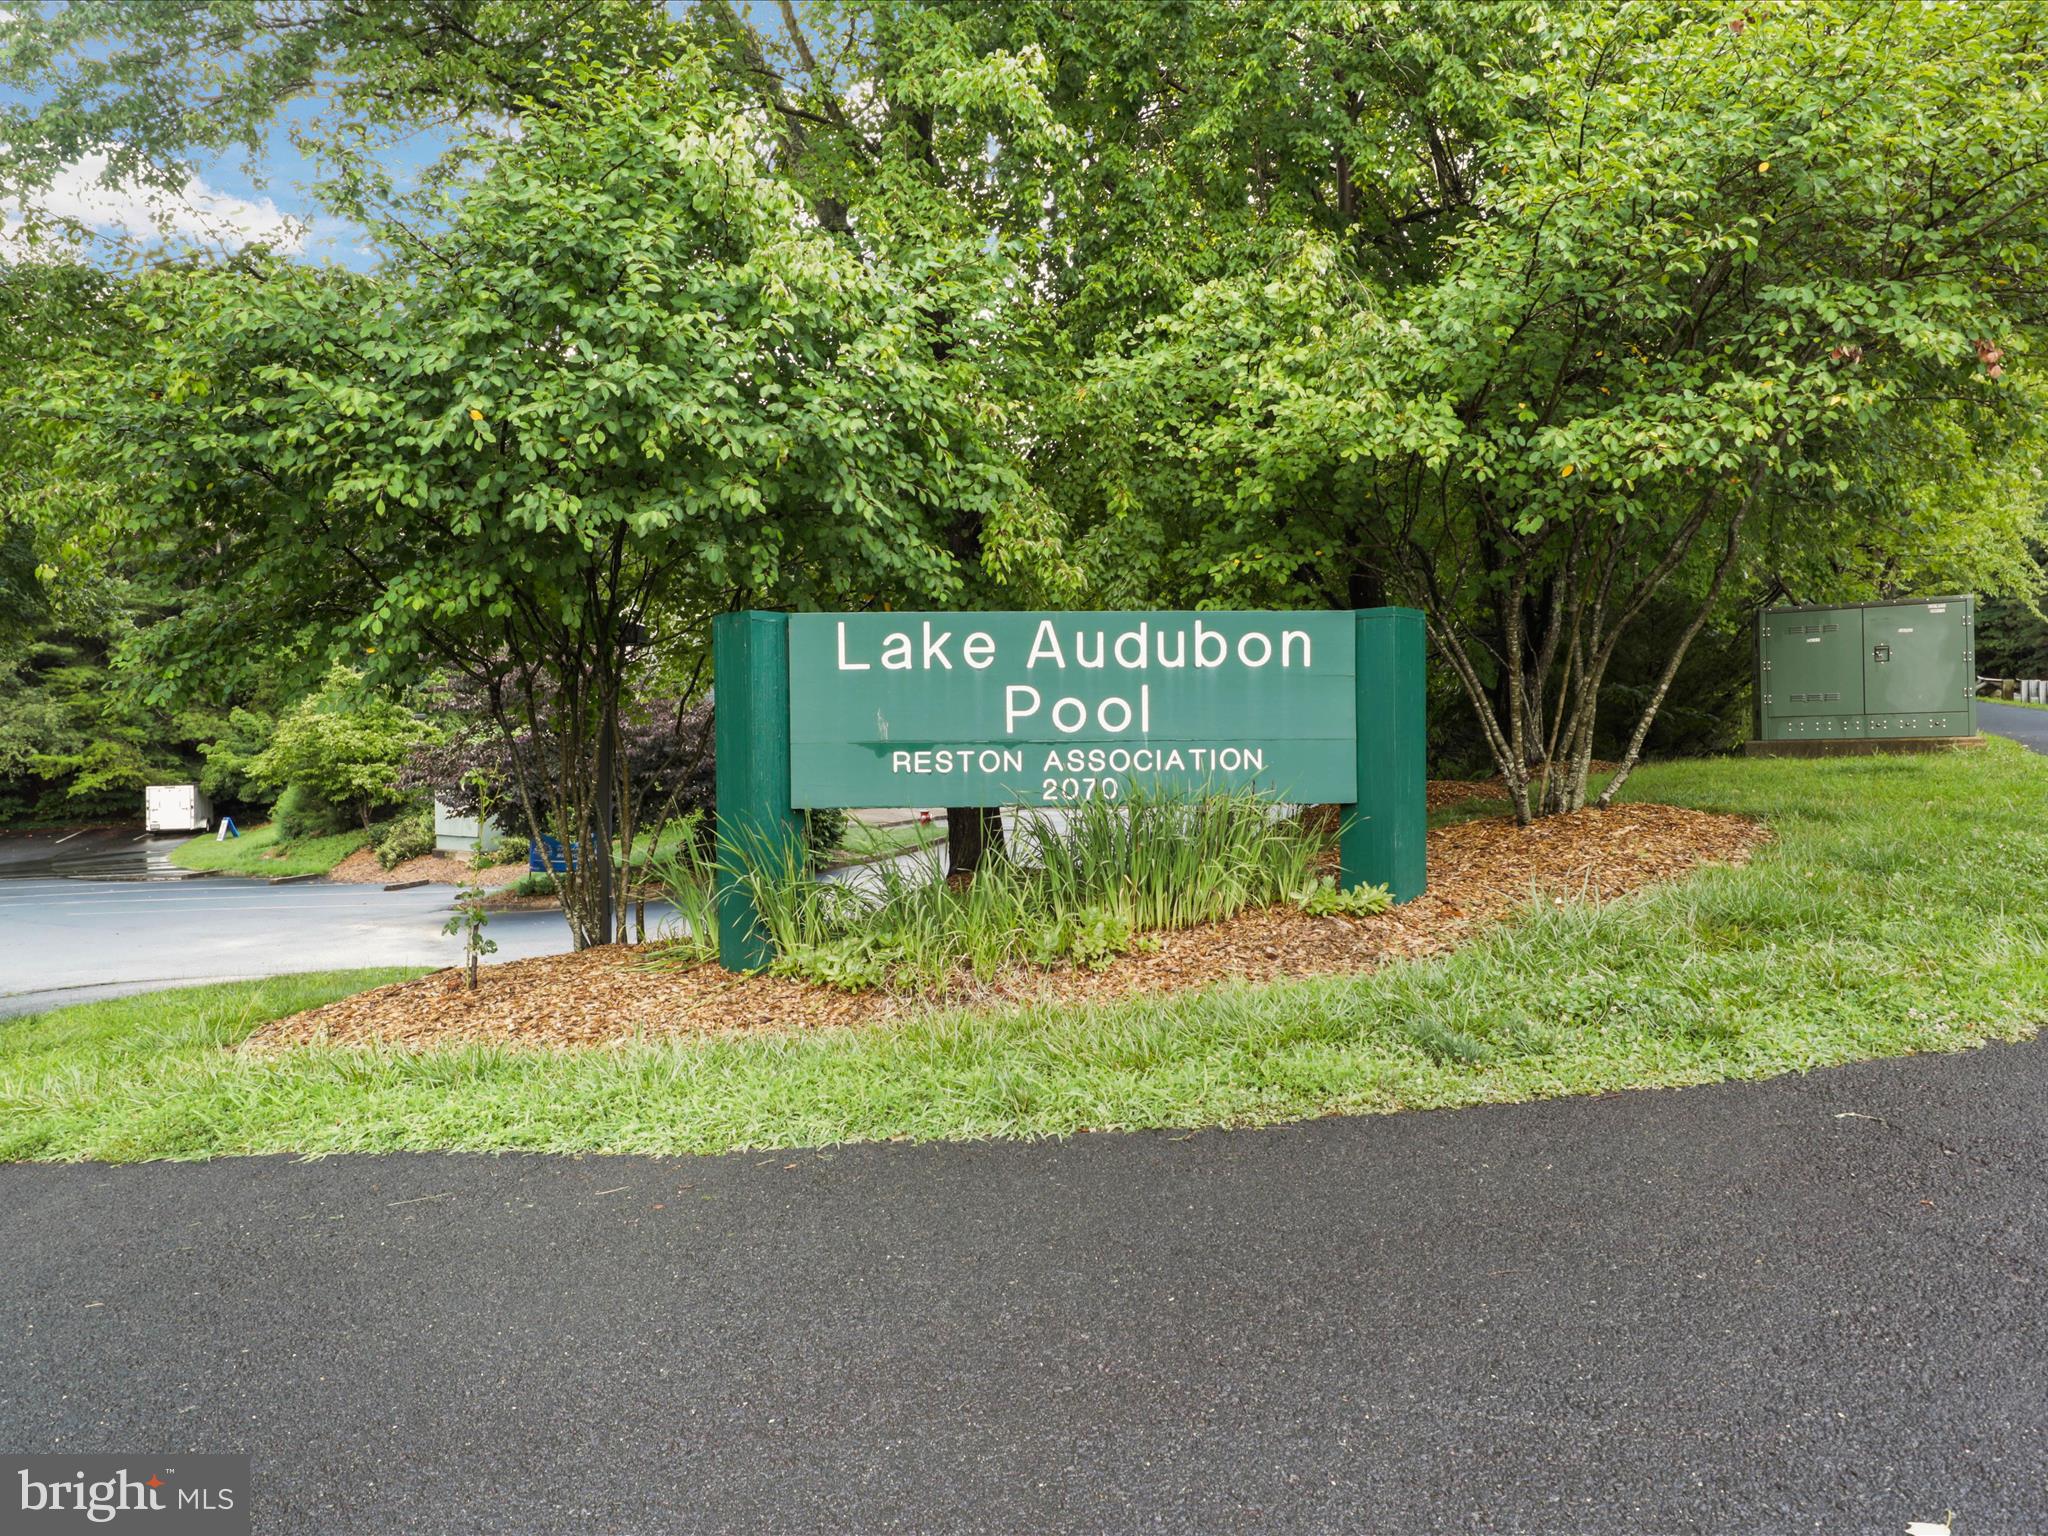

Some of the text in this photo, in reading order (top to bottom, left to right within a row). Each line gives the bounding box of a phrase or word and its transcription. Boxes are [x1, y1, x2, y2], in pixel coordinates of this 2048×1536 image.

[836, 619, 1312, 671] Lake Audubon
[1004, 683, 1150, 734] Pool
[892, 747, 1264, 774] RESTON ASSOCIATION
[1042, 777, 1118, 801] 2070
